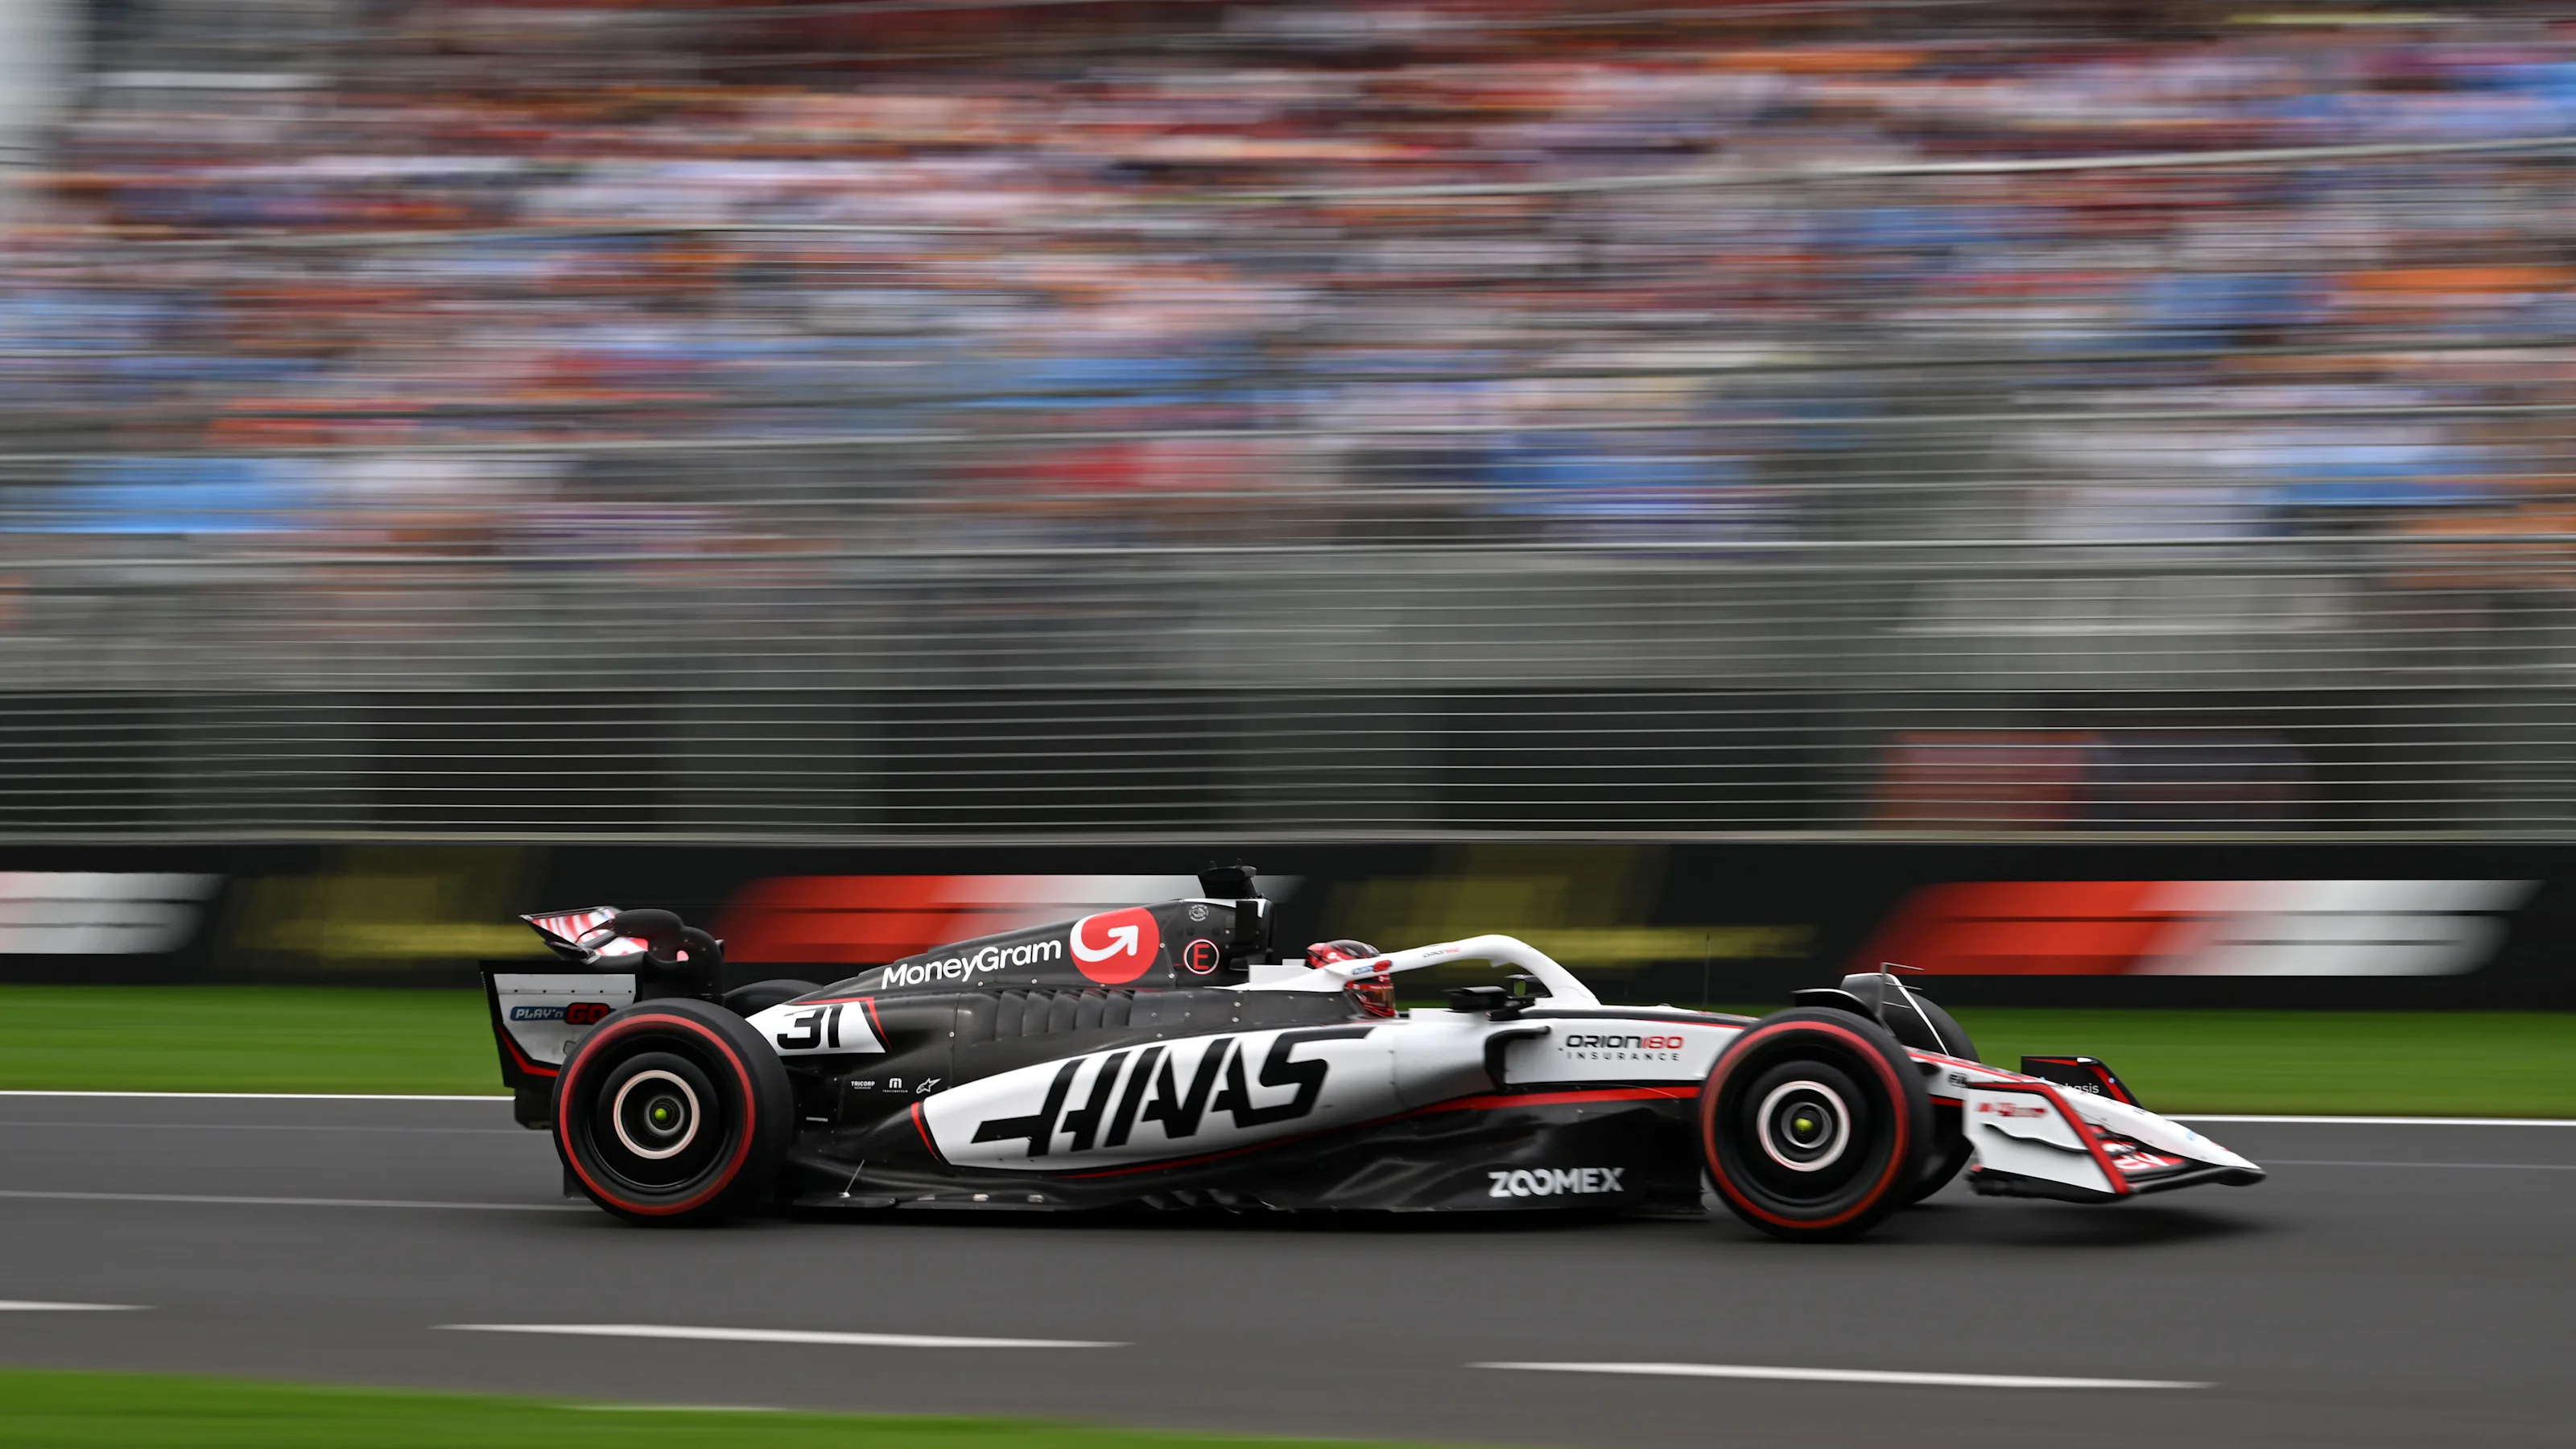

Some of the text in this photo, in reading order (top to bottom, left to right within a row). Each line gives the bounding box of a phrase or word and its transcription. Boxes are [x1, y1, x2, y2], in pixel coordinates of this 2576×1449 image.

[881, 939, 1062, 990] MoneyGram
[1193, 943, 1210, 970] E
[777, 1004, 844, 1050] 31
[1567, 1034, 1685, 1049] ORION180
[1567, 1051, 1680, 1061] INSURANCE
[971, 1026, 1377, 1158] HAAS
[1488, 1167, 1624, 1198] ZOOMEX
